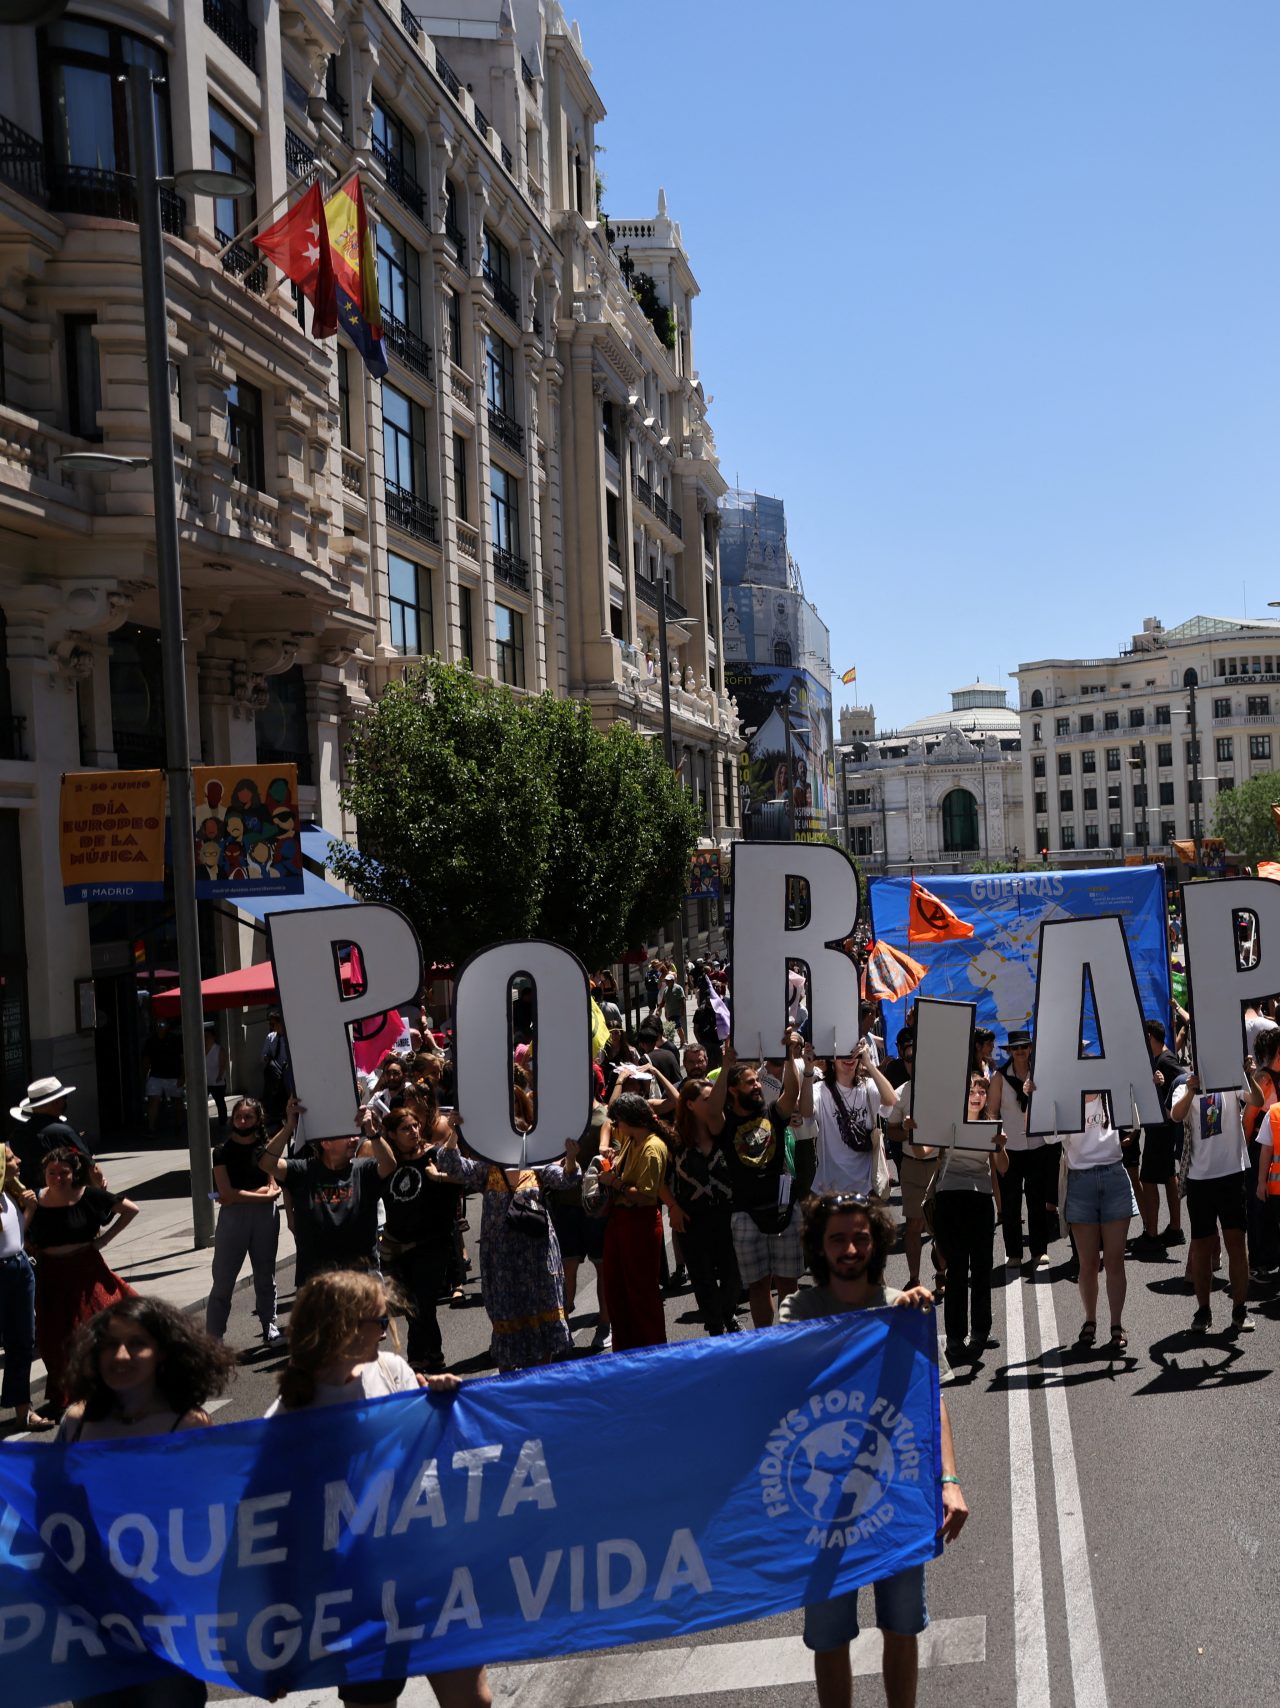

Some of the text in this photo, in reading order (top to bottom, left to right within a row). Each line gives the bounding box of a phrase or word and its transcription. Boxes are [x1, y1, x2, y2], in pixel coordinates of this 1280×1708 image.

[1224, 675, 1256, 684] EDIFICIO
[92, 800, 129, 815] DÍA
[63, 817, 159, 833] EUROPEO
[80, 833, 138, 849] DE LA
[70, 848, 149, 865] MÚSICA
[92, 887, 134, 896] MADRID
[970, 875, 1065, 901] GUERRAS
[759, 1390, 920, 1518] FRIDAYS FOR FUTURE
[0, 1437, 557, 1584] LO QUE MATA
[804, 1503, 895, 1550] MADRID
[384, 1565, 482, 1641] LA
[509, 1527, 713, 1623] VIDA
